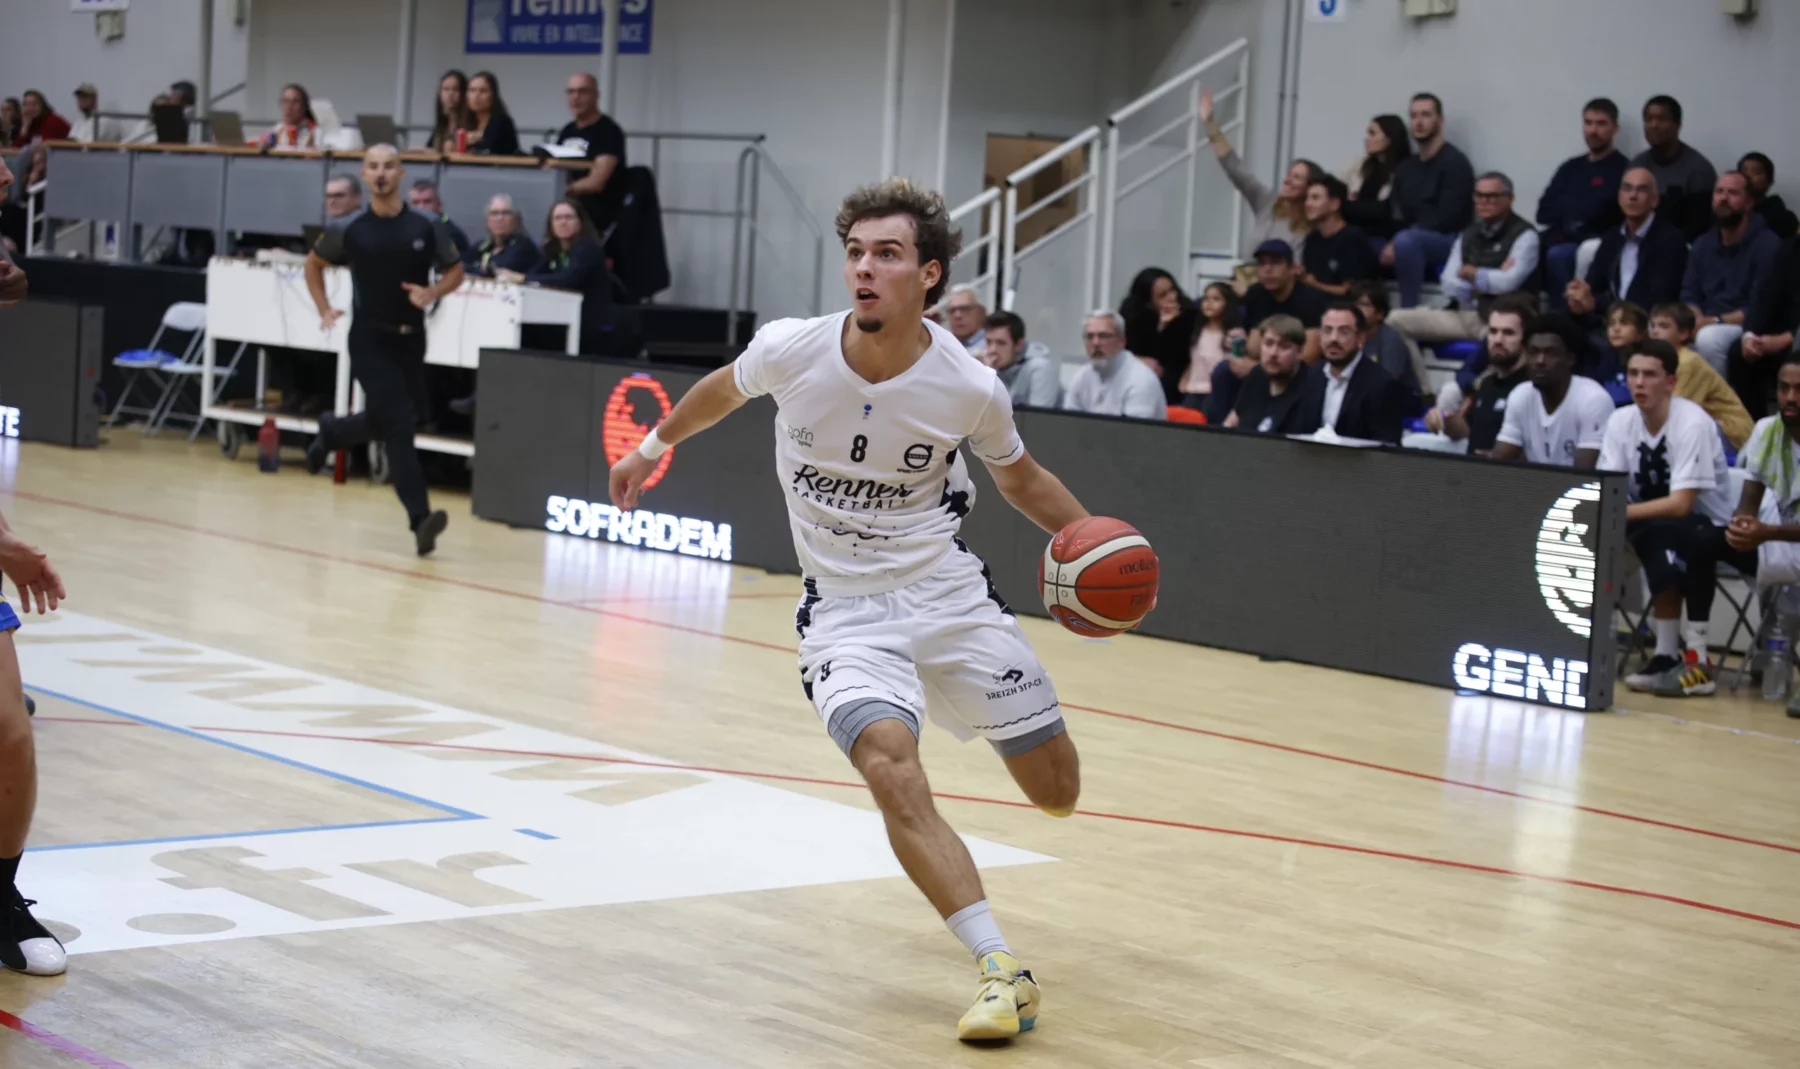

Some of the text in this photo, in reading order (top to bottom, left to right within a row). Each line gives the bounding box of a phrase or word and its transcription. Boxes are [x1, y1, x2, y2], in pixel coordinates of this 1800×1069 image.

[511, 0, 648, 16] renns
[850, 434, 868, 463] 8
[545, 495, 733, 561] SOFRADEM
